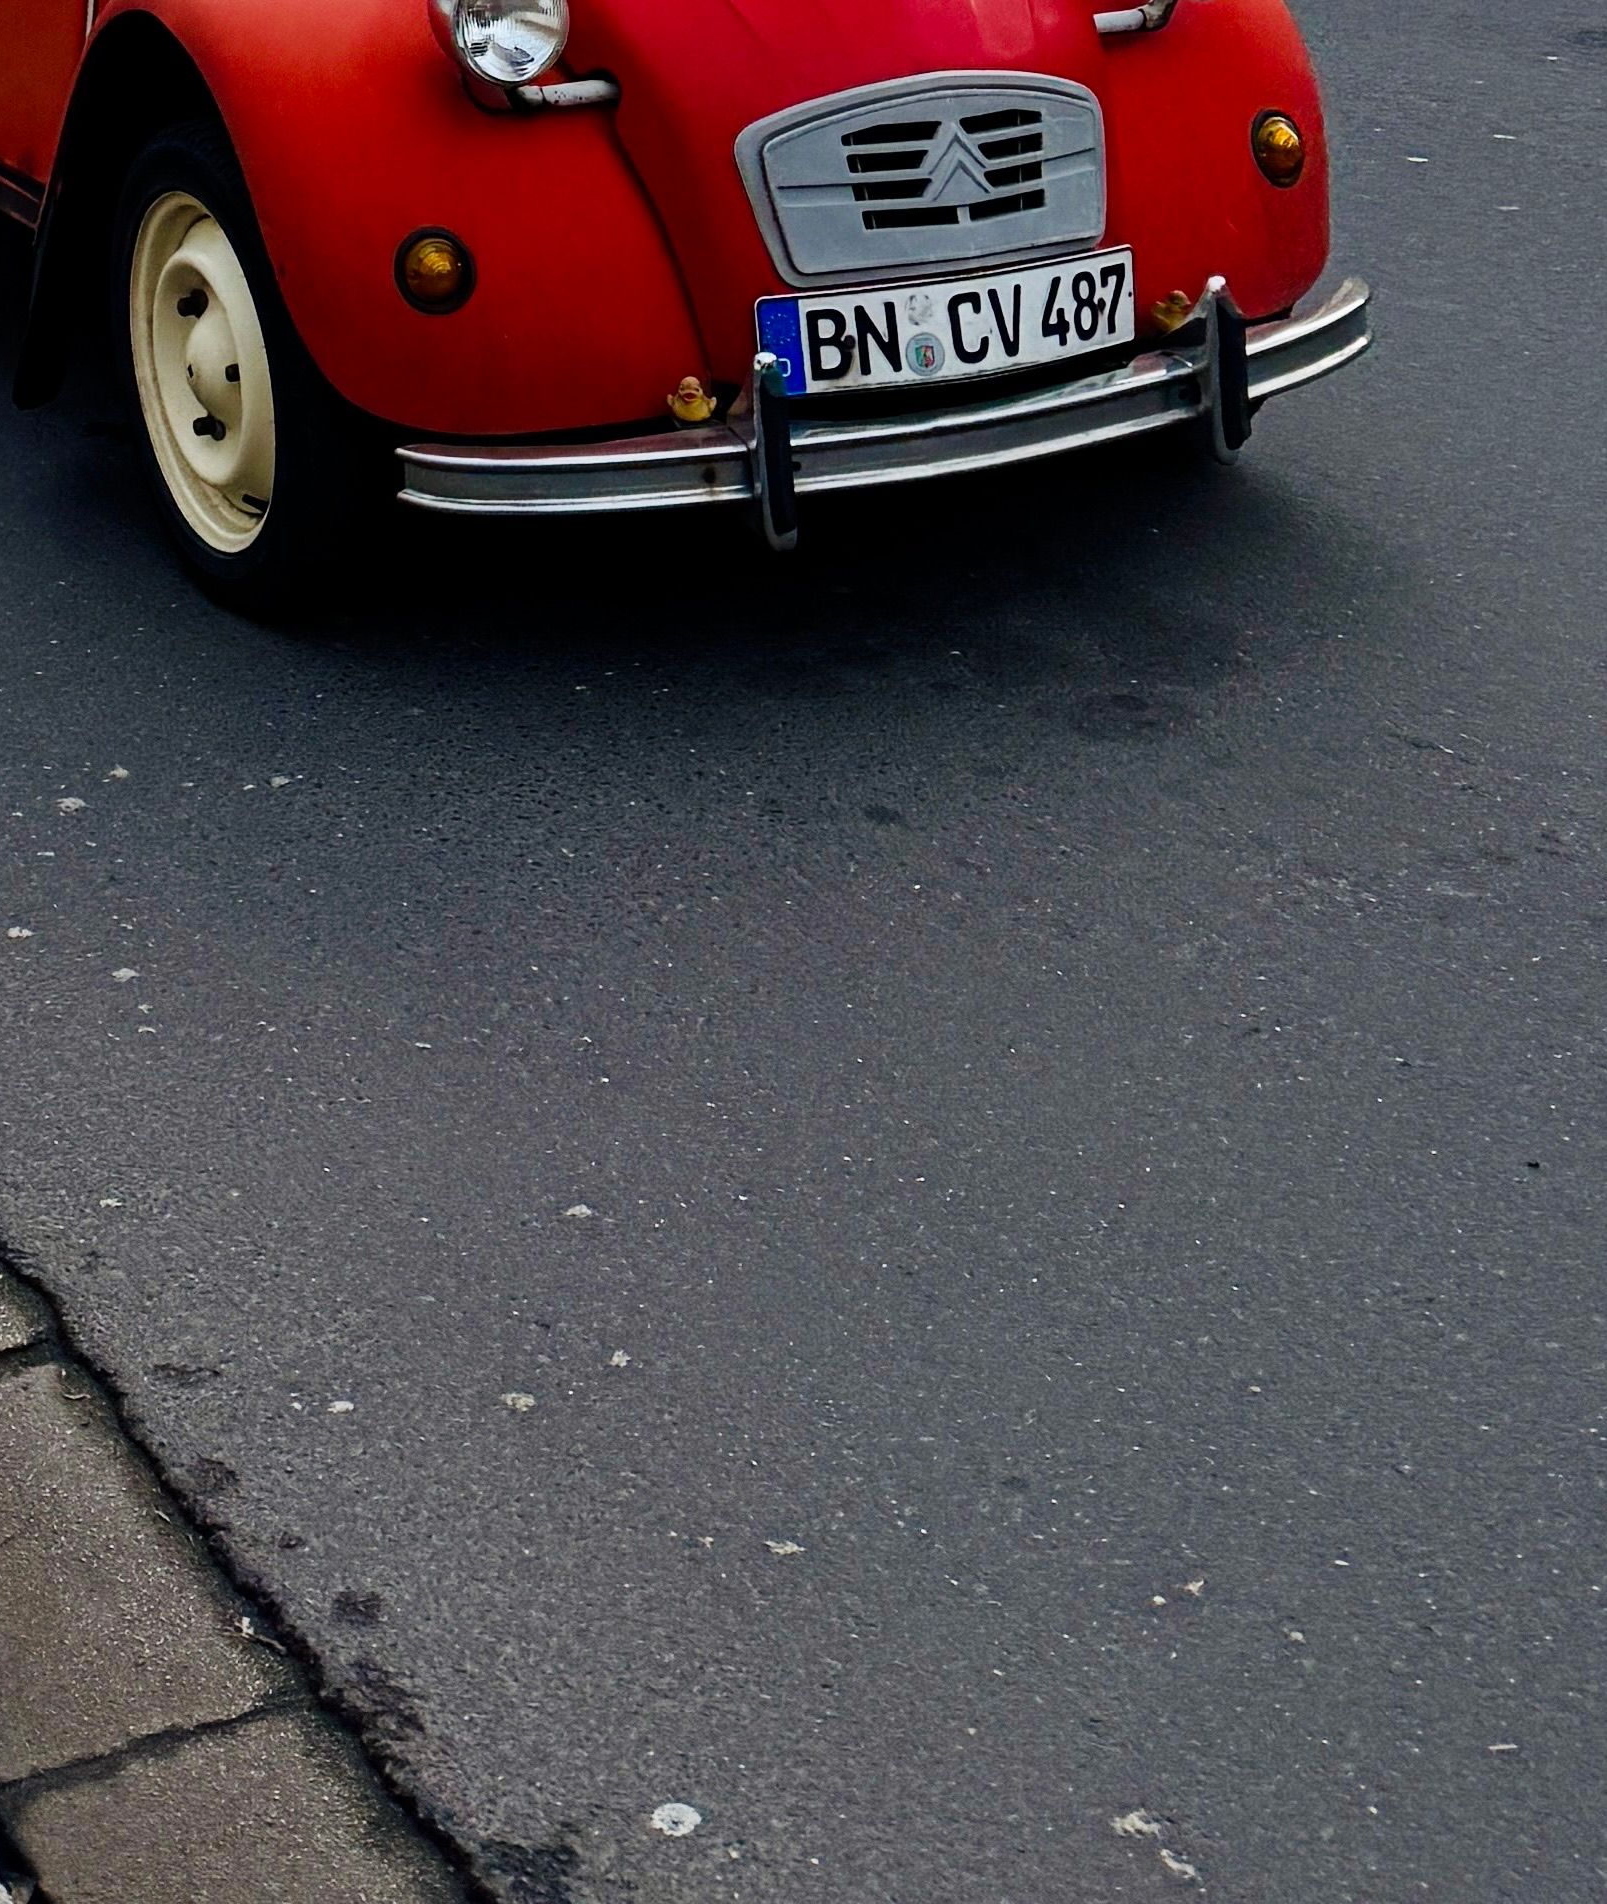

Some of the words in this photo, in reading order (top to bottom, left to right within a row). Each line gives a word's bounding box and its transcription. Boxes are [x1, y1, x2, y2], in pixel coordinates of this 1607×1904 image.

[805, 301, 903, 382] BN
[947, 283, 1022, 365] CV
[1041, 262, 1126, 347] 487
